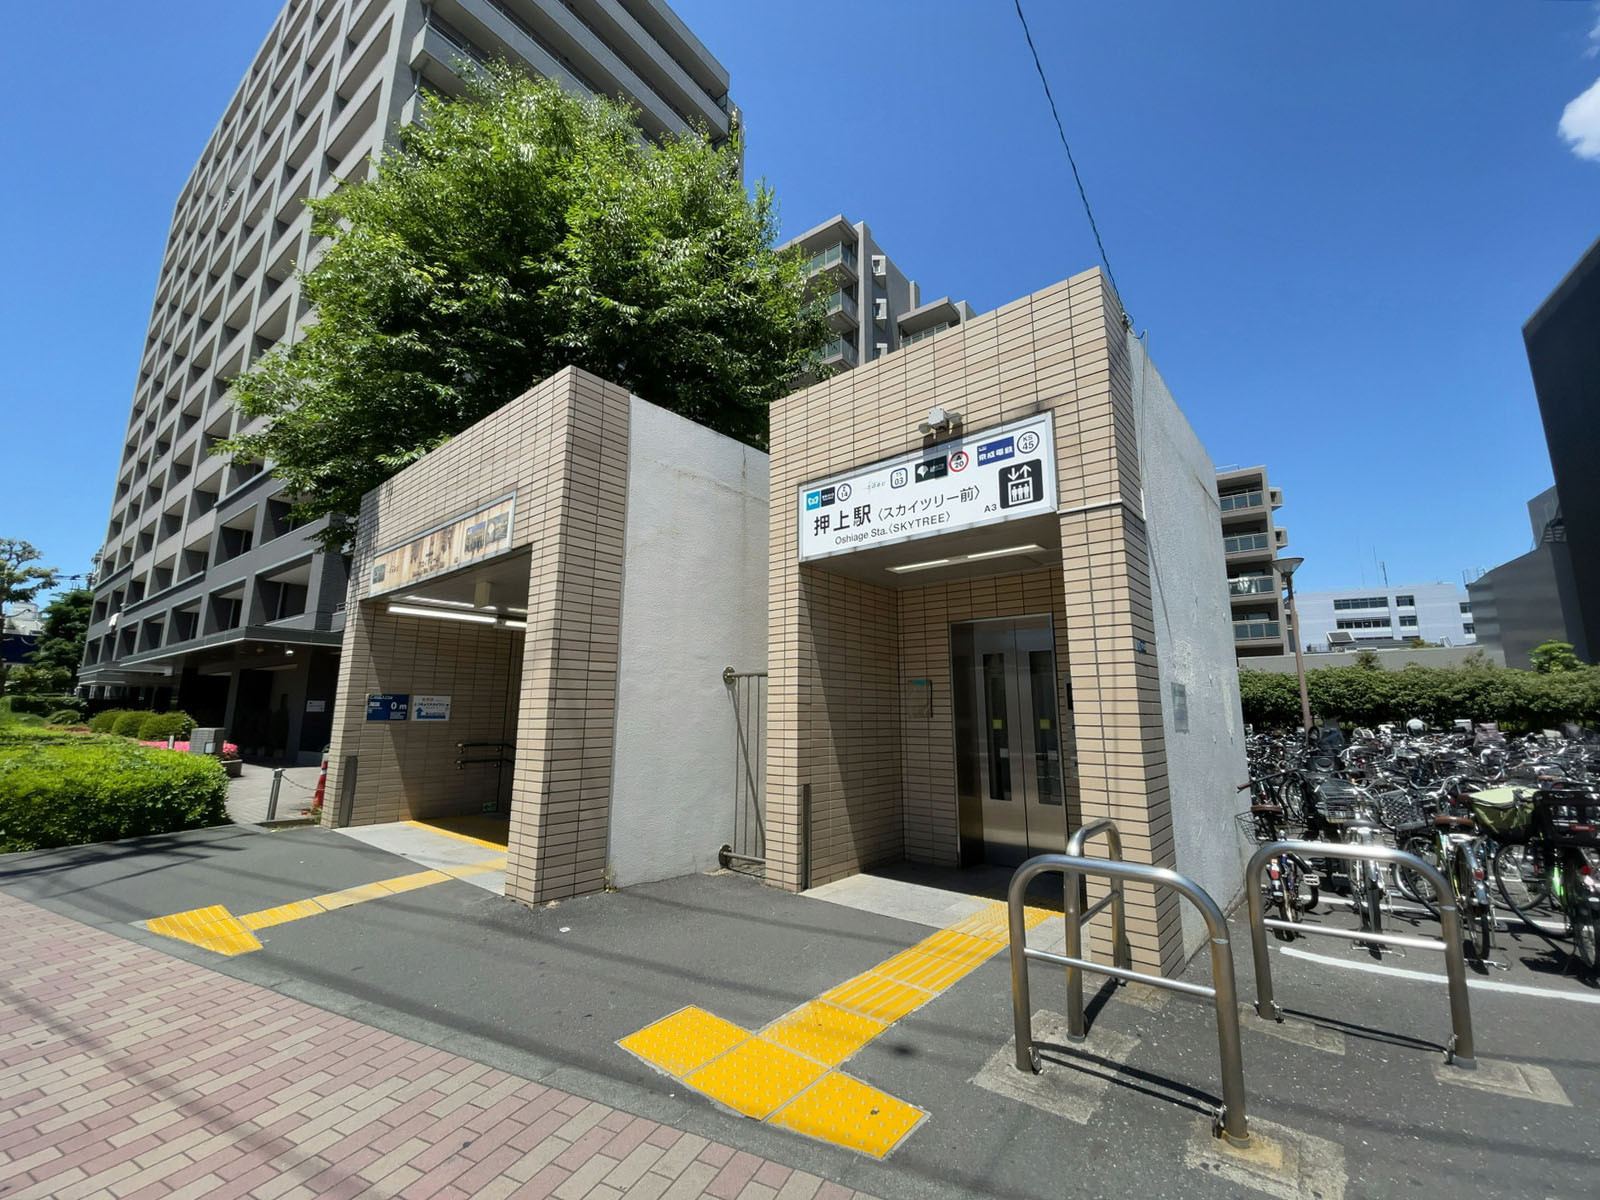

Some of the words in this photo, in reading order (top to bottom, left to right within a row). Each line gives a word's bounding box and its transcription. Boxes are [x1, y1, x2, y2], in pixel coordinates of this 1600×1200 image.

[1022, 441, 1034, 450] 45
[954, 460, 965, 469] 20
[894, 476, 904, 486] 03
[983, 503, 998, 514] A3
[813, 503, 872, 537] 押上駅
[834, 531, 869, 546] Oshiage
[870, 527, 888, 538] Sta.
[390, 701, 398, 711] 0
[399, 703, 408, 711] m
